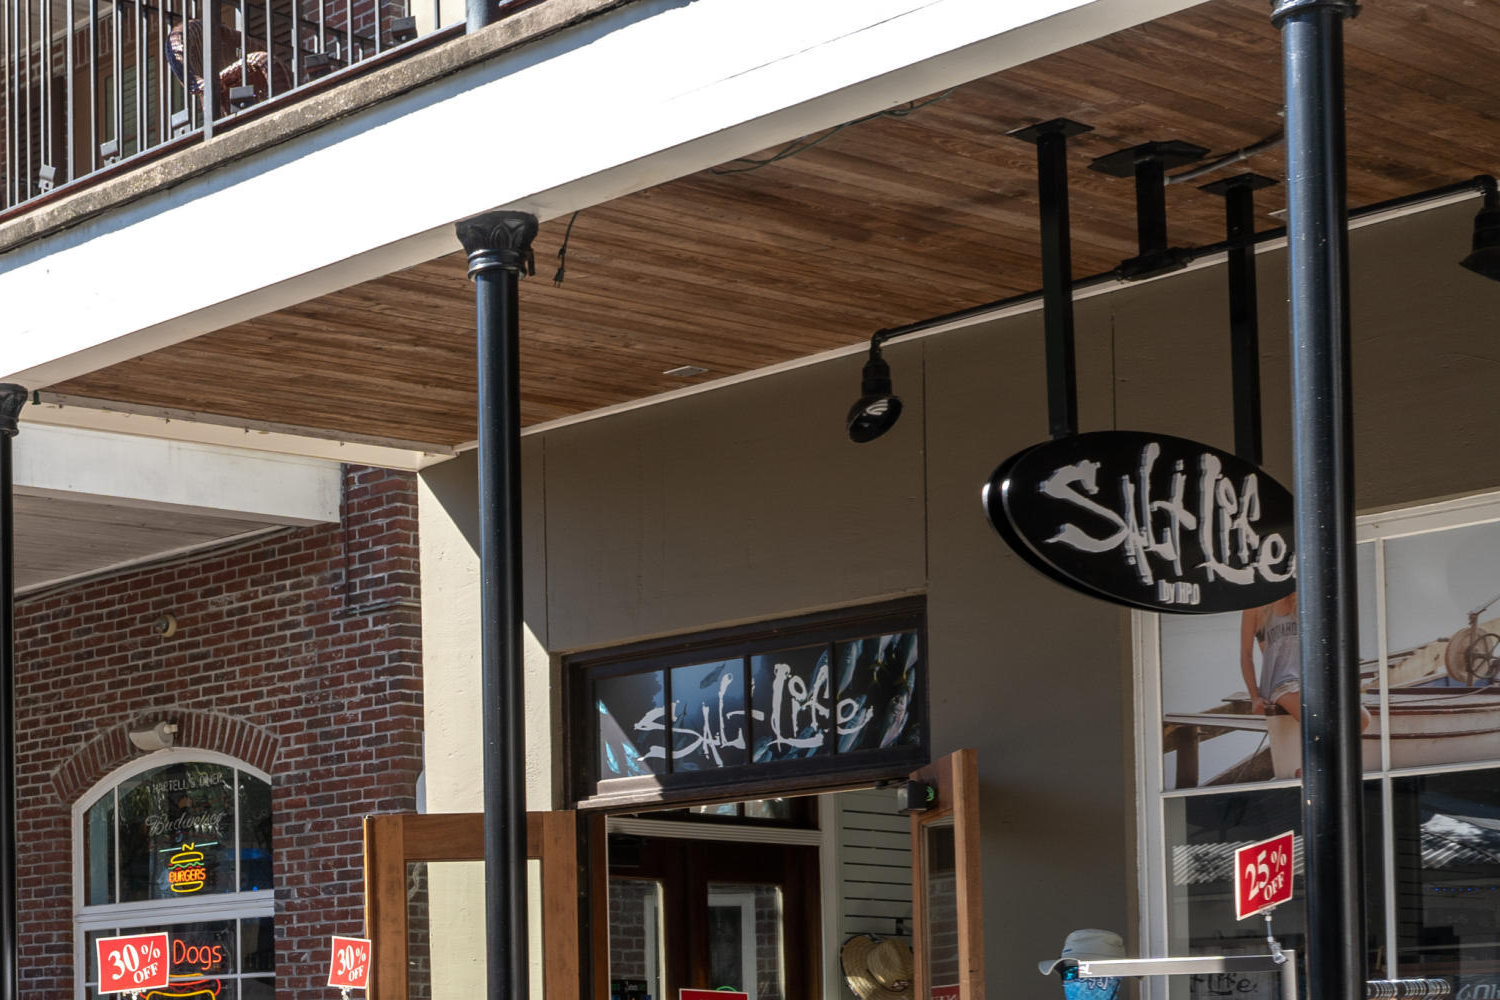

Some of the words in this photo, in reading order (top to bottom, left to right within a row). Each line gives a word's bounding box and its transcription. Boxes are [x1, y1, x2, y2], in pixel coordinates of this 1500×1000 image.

[1157, 579, 1176, 604] by
[168, 867, 207, 884] BURGERS
[1263, 871, 1285, 901] OFF
[172, 939, 223, 971] Dogs
[133, 962, 159, 984] OFF
[348, 965, 365, 982] OFF
